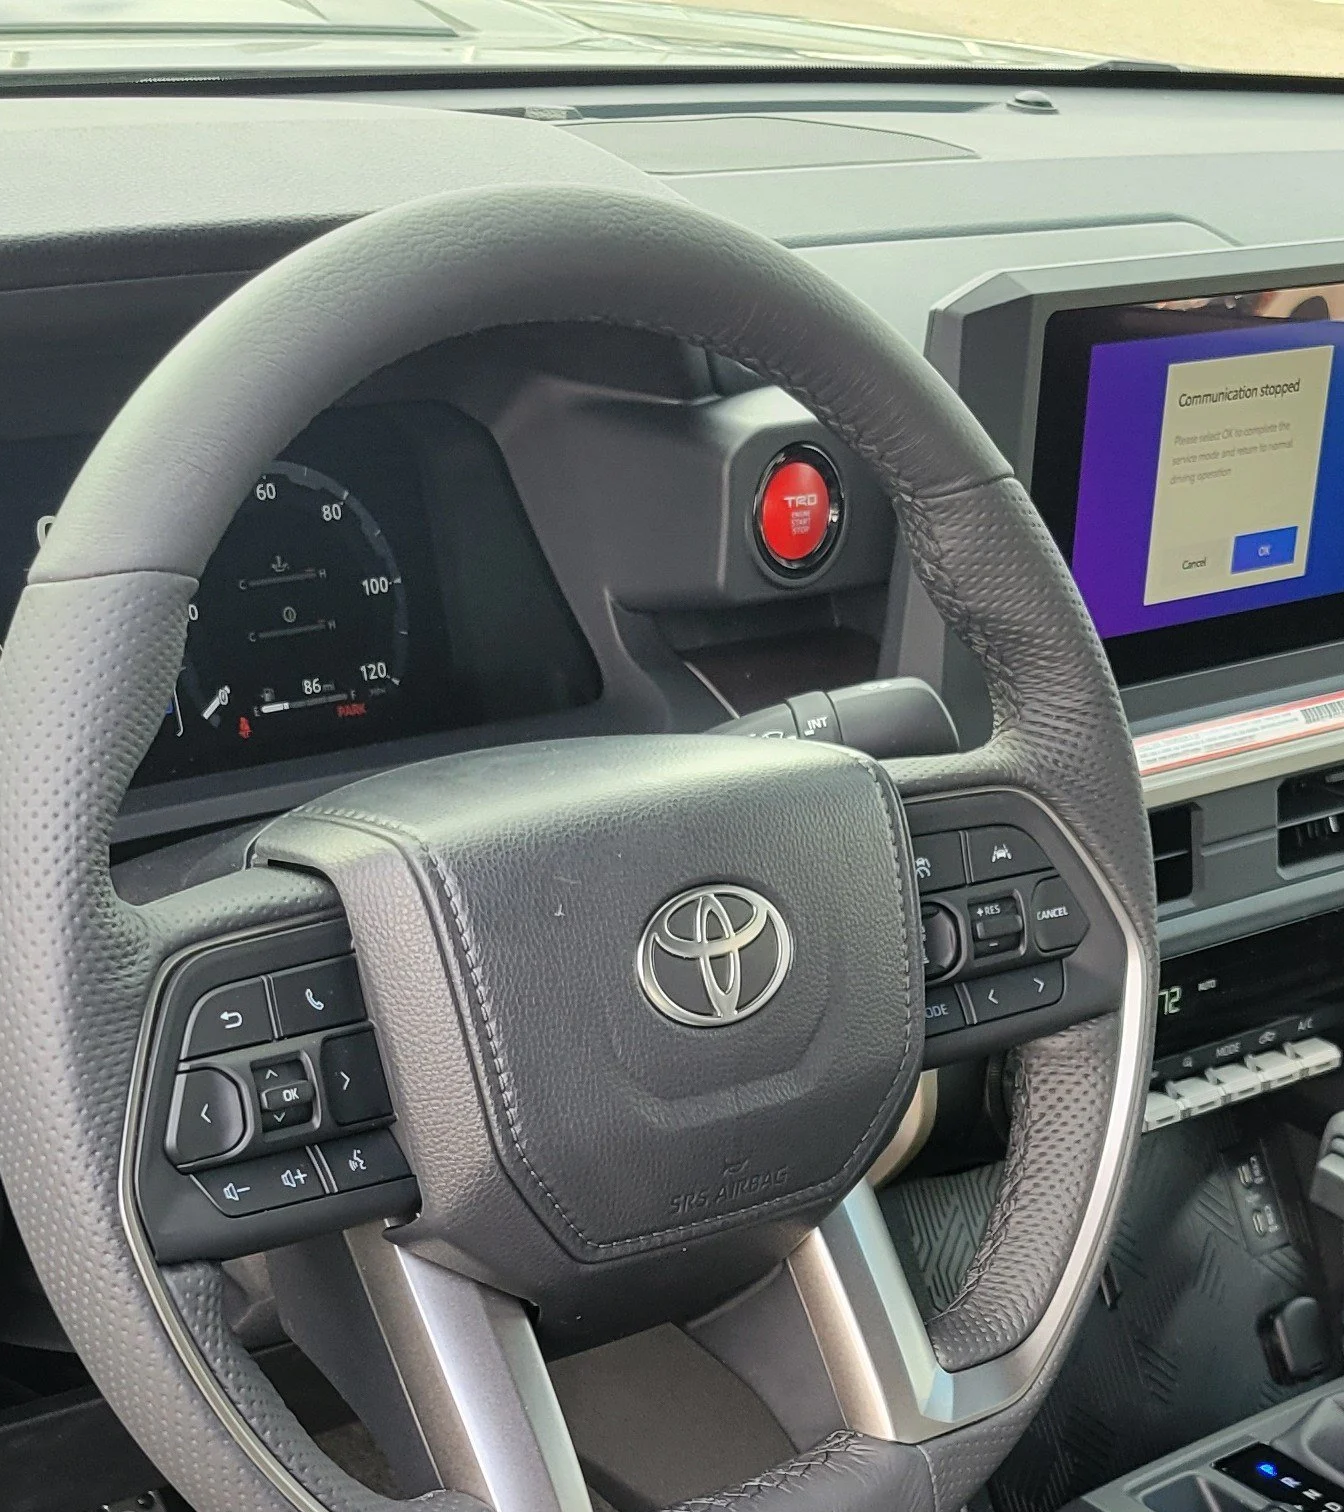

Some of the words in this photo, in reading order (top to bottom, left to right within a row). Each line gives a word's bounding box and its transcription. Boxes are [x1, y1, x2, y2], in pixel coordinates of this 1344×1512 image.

[1178, 385, 1258, 408] Communication
[1260, 377, 1301, 398] stopped
[256, 482, 277, 501] 60
[783, 493, 819, 508] TRD
[321, 503, 343, 522] 80
[1181, 556, 1207, 570] Cancel
[361, 576, 390, 596] 100
[359, 662, 387, 681] 120
[807, 716, 828, 731] INT
[1036, 906, 1069, 921] CANCEL
[1158, 985, 1182, 1015] 72
[924, 1003, 949, 1019] ODE
[282, 1087, 300, 1103] OK
[716, 1166, 790, 1205] AIRBAG
[1279, 1475, 1302, 1489] R
